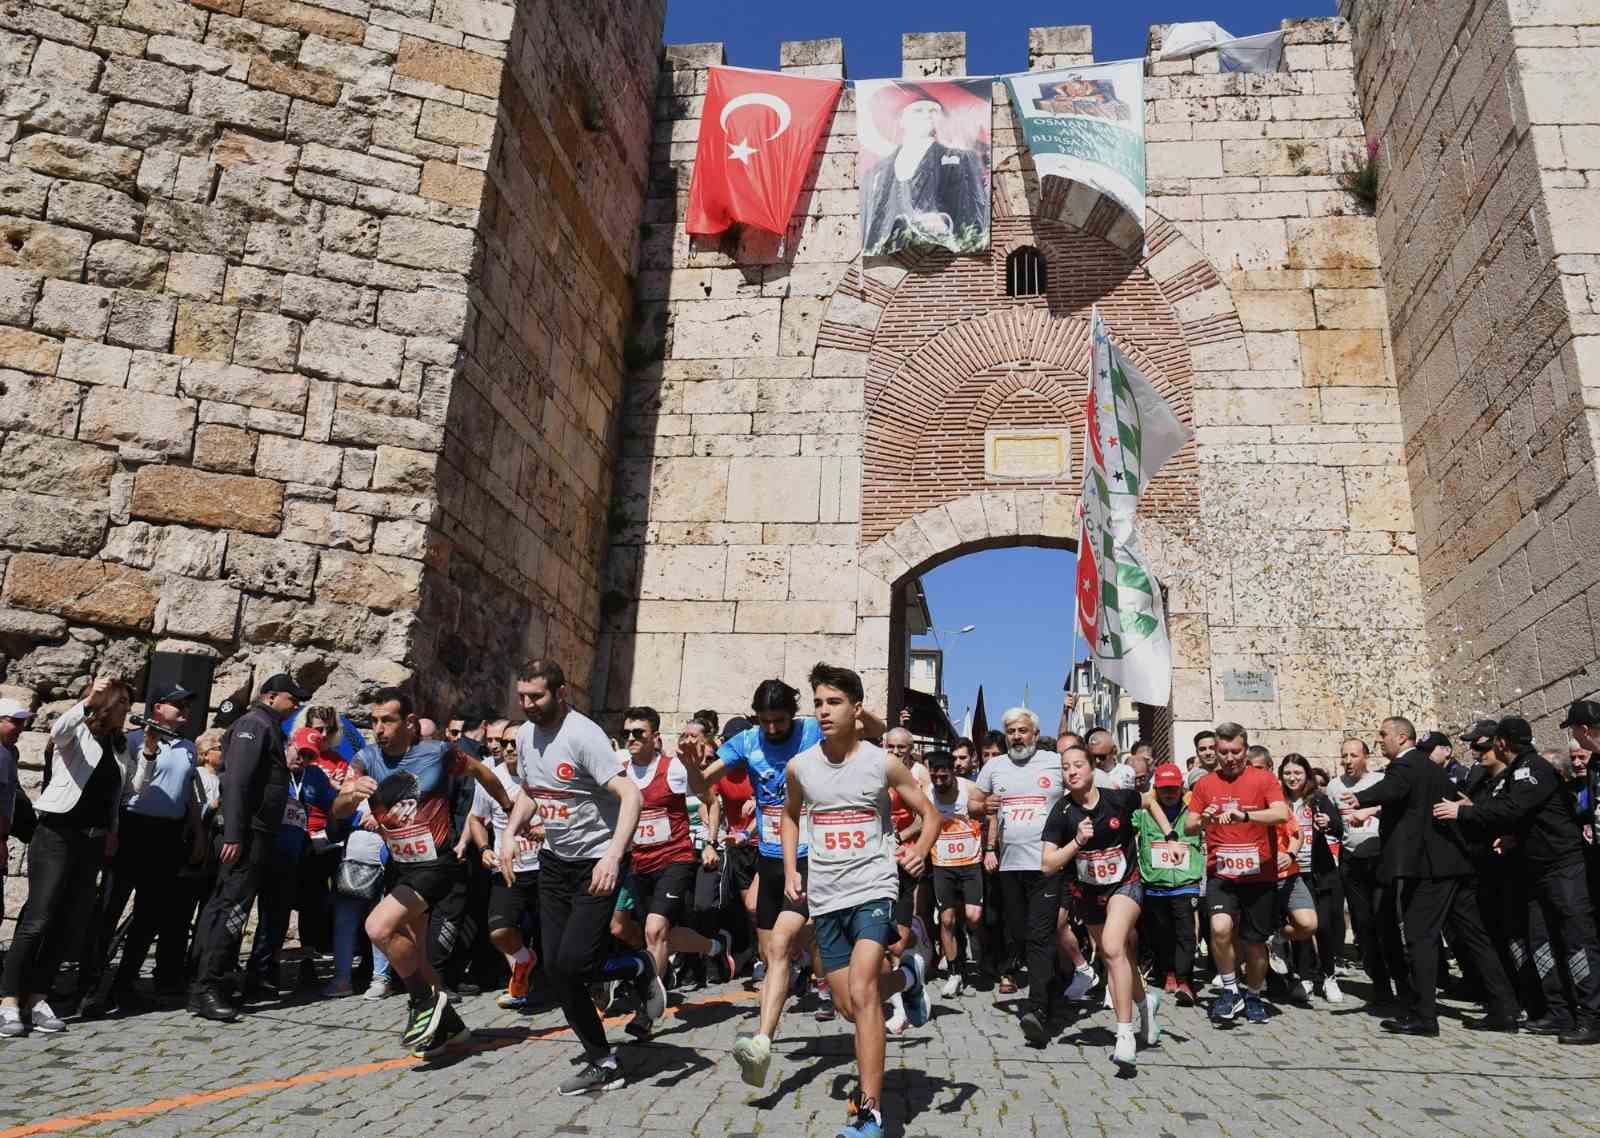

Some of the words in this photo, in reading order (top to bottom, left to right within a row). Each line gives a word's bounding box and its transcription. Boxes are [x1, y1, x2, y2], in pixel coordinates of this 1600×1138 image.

[1033, 118, 1088, 130] OSMAN
[1011, 807, 1035, 821] 777
[824, 830, 865, 850] 553
[391, 839, 428, 857] 245
[947, 842, 965, 854] 80
[1087, 862, 1117, 878] 589
